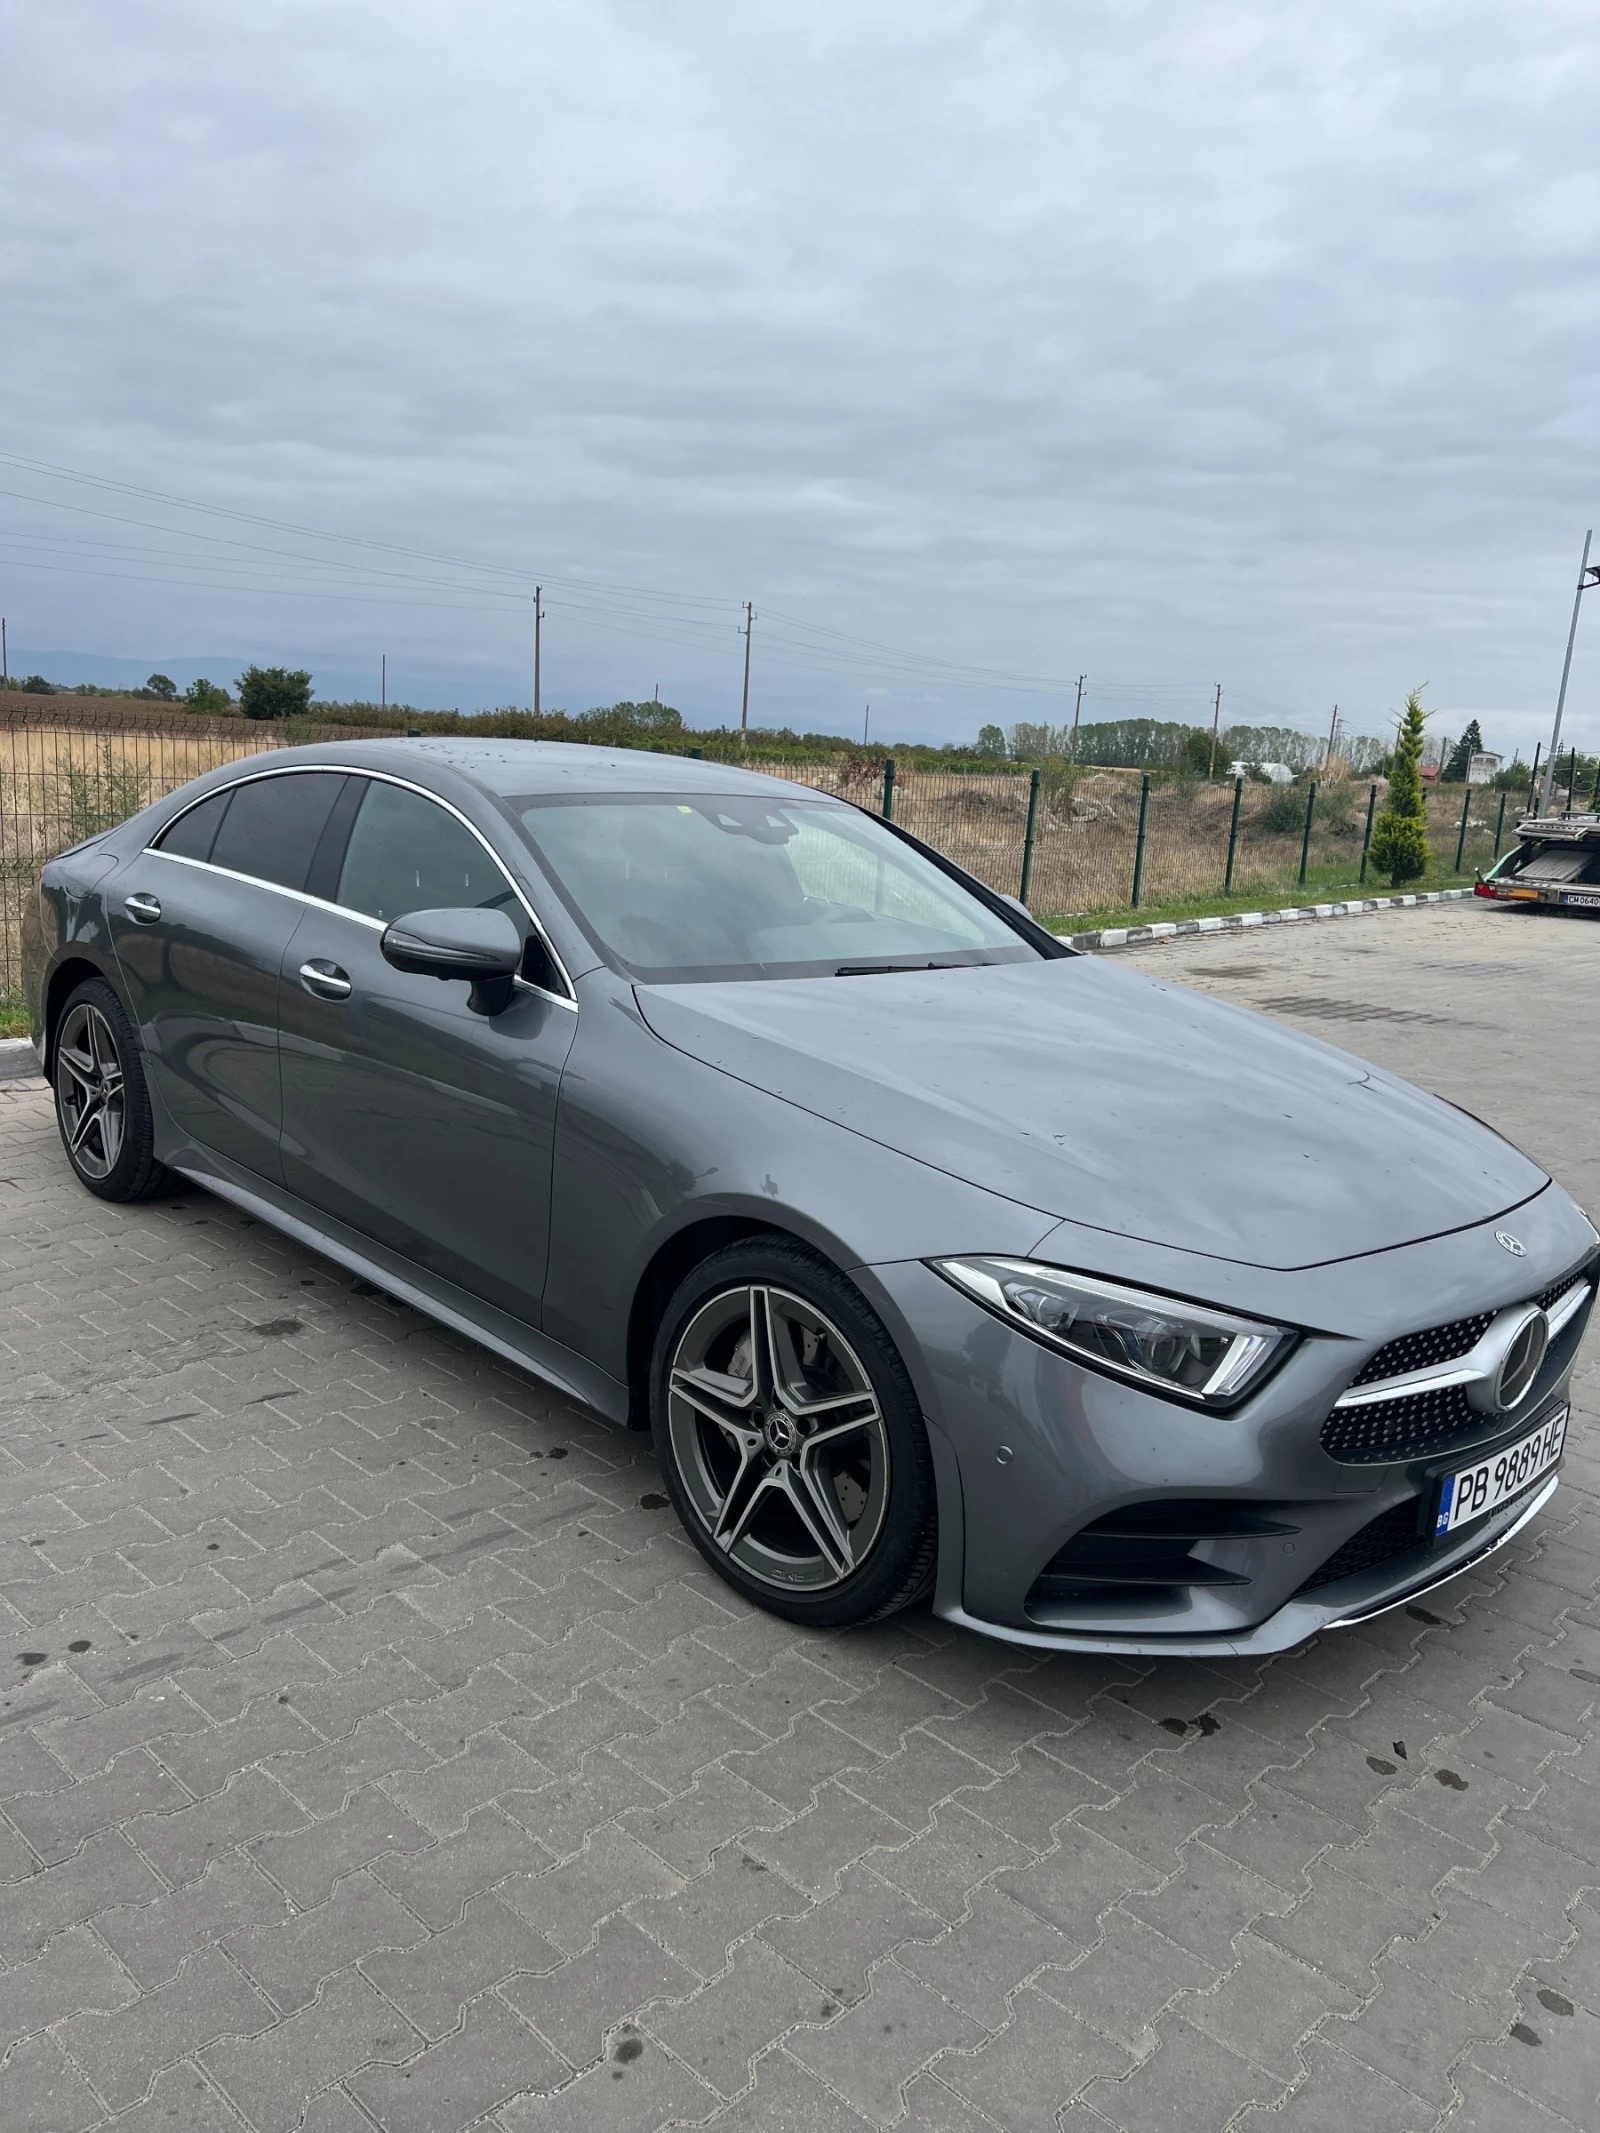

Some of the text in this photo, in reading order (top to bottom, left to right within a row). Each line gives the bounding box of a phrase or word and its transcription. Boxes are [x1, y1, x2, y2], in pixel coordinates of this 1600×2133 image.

[1568, 895, 1579, 904] CM
[1579, 896, 1599, 906] 0640
[1454, 1466, 1489, 1521] PB
[1494, 1434, 1542, 1500] 9889
[1539, 1414, 1565, 1468] HE
[1437, 1511, 1449, 1528] BG
